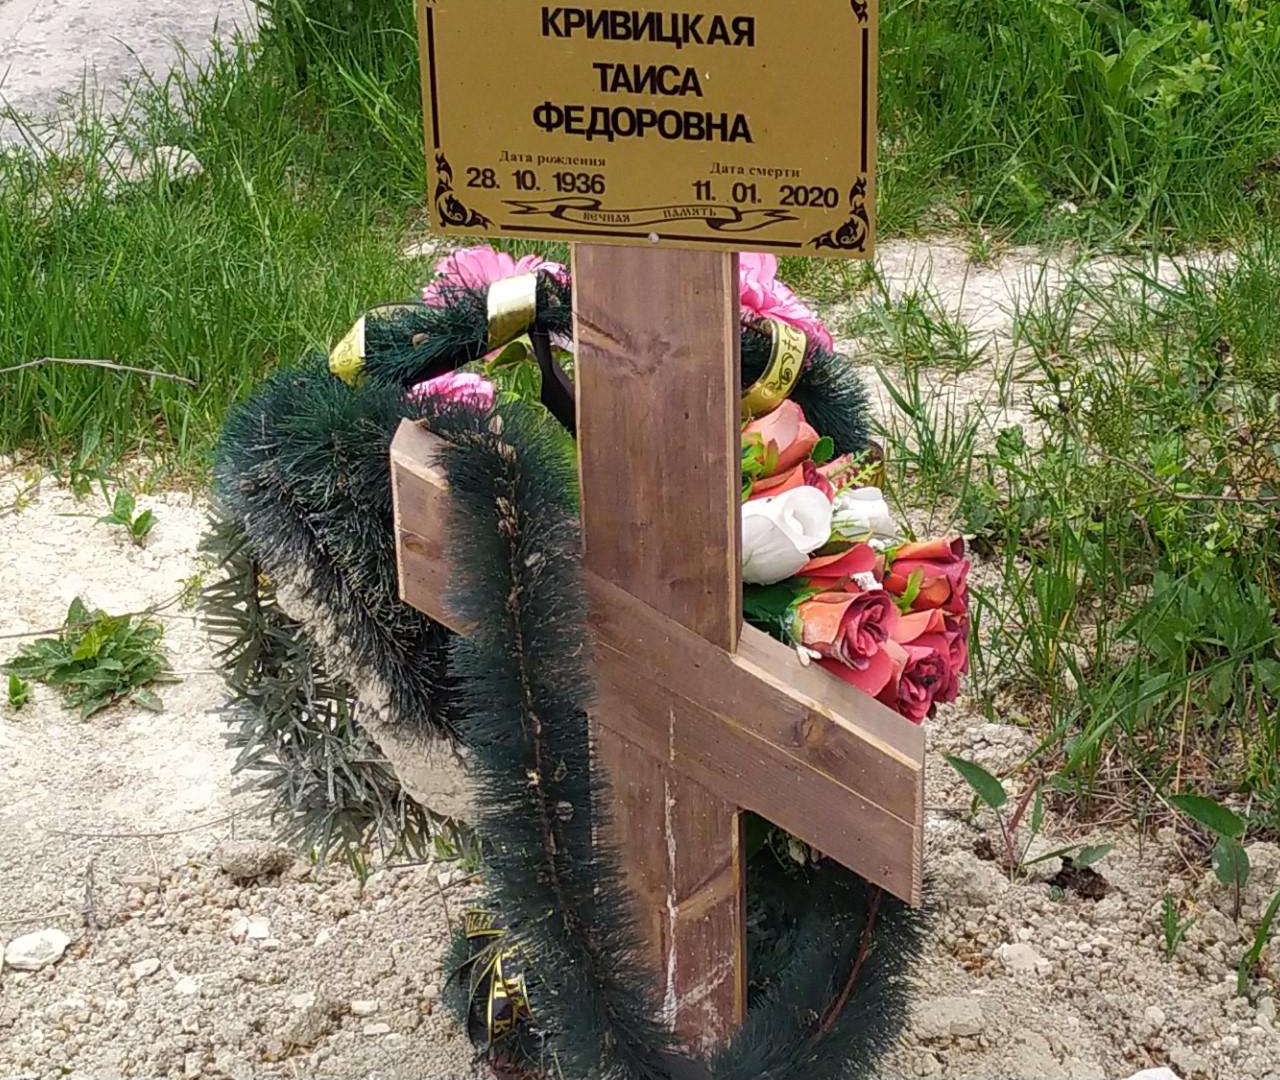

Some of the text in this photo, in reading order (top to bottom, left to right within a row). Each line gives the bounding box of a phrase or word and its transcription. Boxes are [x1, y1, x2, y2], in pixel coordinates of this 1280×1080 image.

[541, 6, 756, 50] КРИВИЦКАЯ
[592, 62, 704, 98] ТАИСА
[532, 101, 754, 143] ФЕДОРОВНА
[498, 150, 606, 167] Дата рождения
[709, 162, 801, 180] Дата смерти
[466, 166, 606, 195] 28. 10. 1936
[691, 179, 840, 209] 11. 01. 2020
